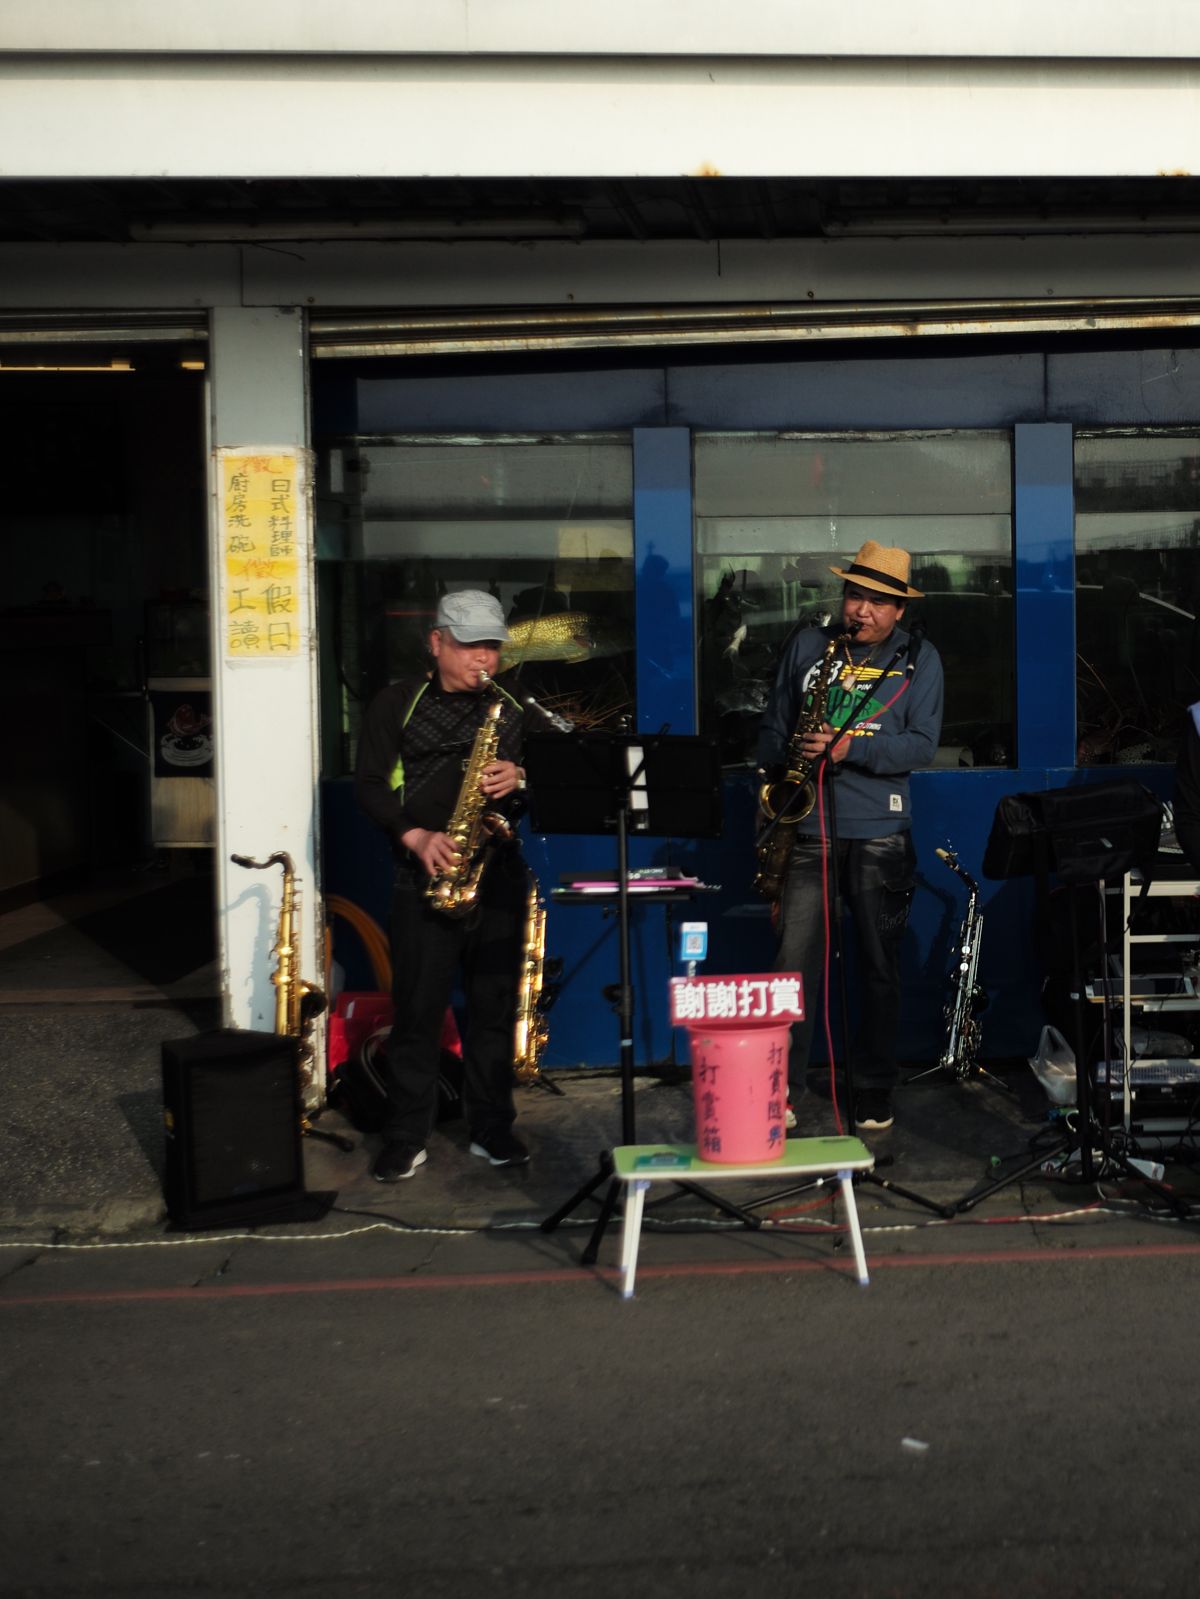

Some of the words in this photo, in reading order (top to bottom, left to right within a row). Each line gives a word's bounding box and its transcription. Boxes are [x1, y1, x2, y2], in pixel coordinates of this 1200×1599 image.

[267, 478, 293, 556] 日式料理師
[241, 558, 284, 581] 徵
[229, 587, 260, 649] 工讀
[261, 583, 293, 651] 假日
[673, 978, 803, 1020] 謝謝打賞
[699, 1055, 722, 1154] 打賞箱
